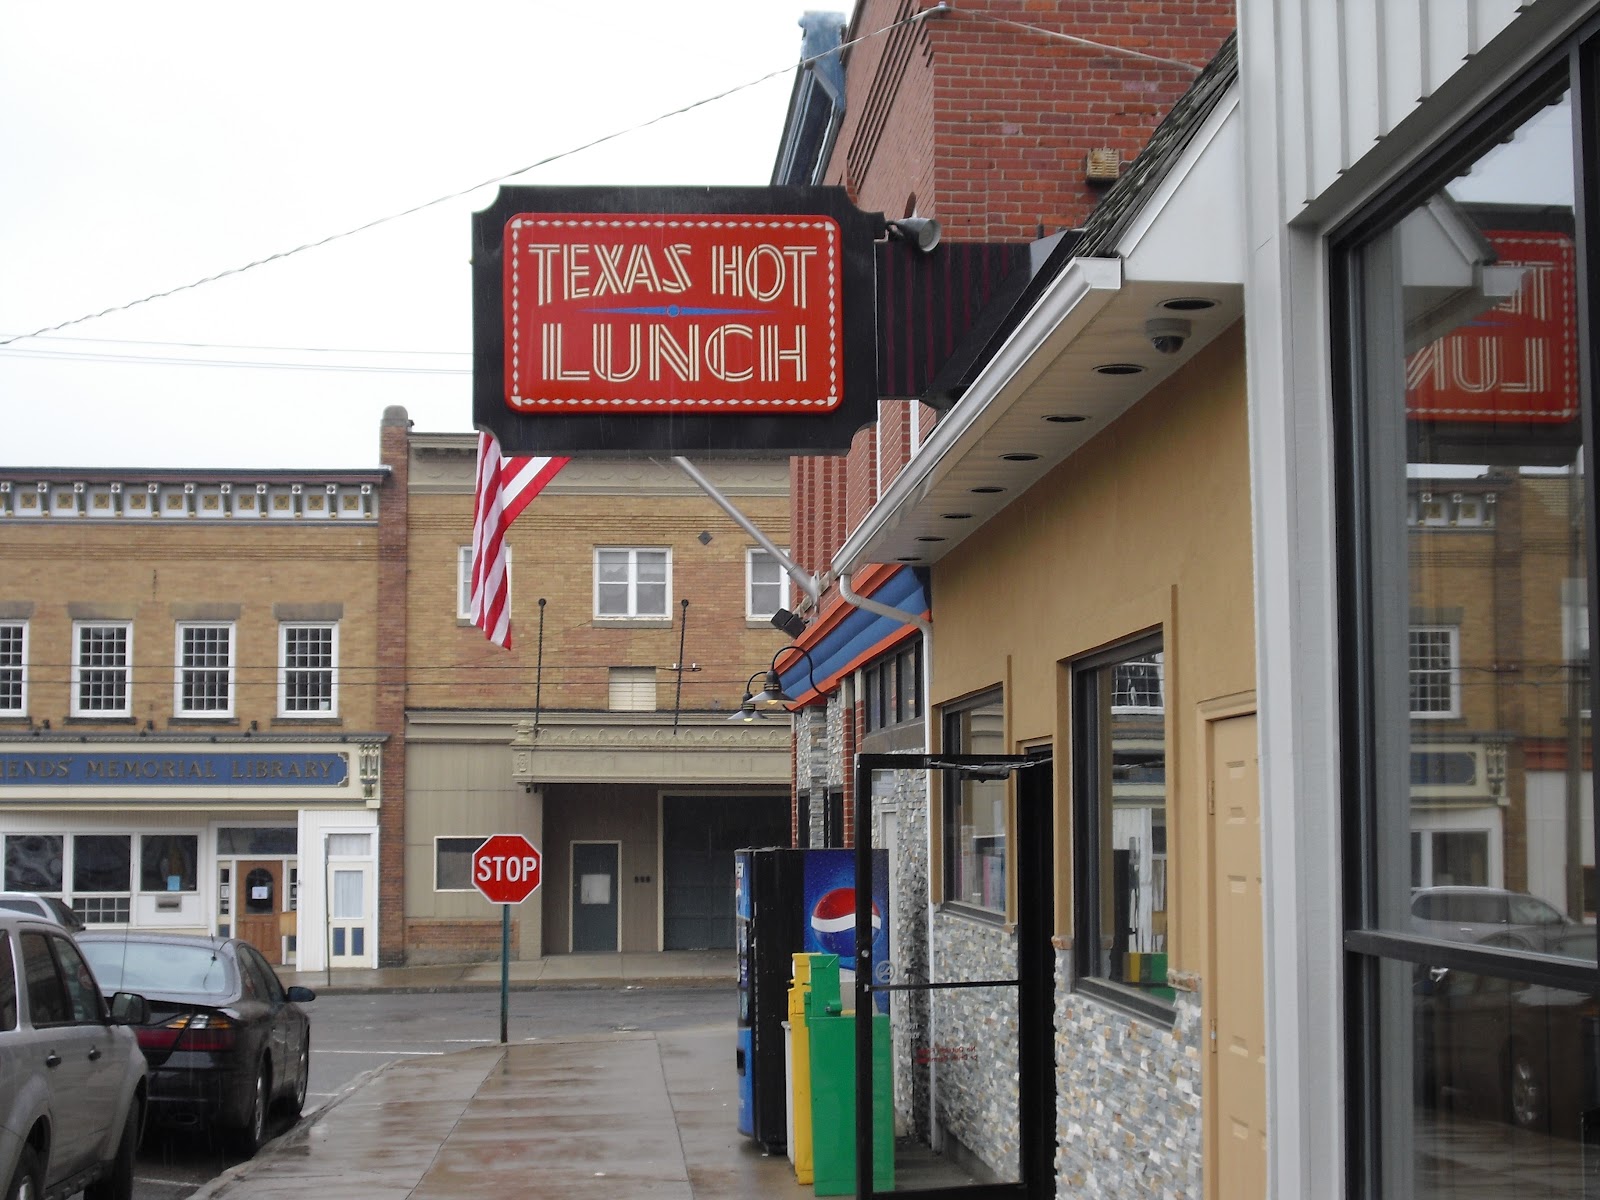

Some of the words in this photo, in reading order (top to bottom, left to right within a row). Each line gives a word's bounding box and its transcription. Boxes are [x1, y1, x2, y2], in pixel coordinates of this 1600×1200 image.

[528, 243, 692, 306] TEXAS
[711, 243, 817, 309] HOT
[541, 323, 807, 382] LUNCH
[85, 760, 217, 779] MEMORIAL
[231, 760, 335, 778] LIBRARY
[477, 856, 537, 882] STOP
